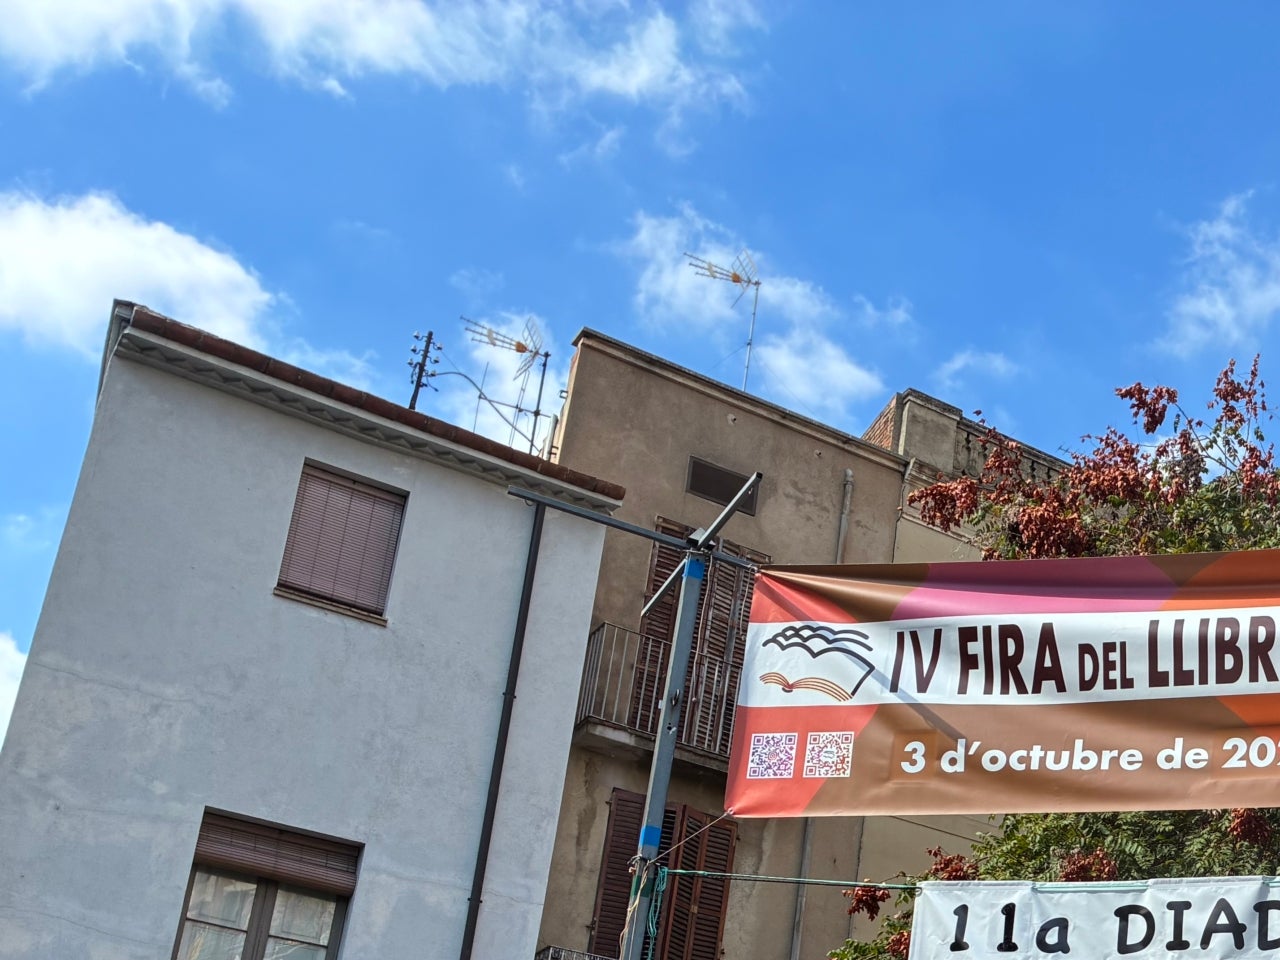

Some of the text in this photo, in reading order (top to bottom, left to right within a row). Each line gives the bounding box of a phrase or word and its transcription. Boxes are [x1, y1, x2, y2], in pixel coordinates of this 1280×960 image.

[889, 628, 942, 693] IV
[957, 622, 1066, 695] FIRA
[1078, 641, 1134, 692] DEL
[901, 742, 926, 773] 3
[941, 737, 1143, 773] d'octubre
[1157, 738, 1208, 769] de
[949, 902, 1069, 954] 11a
